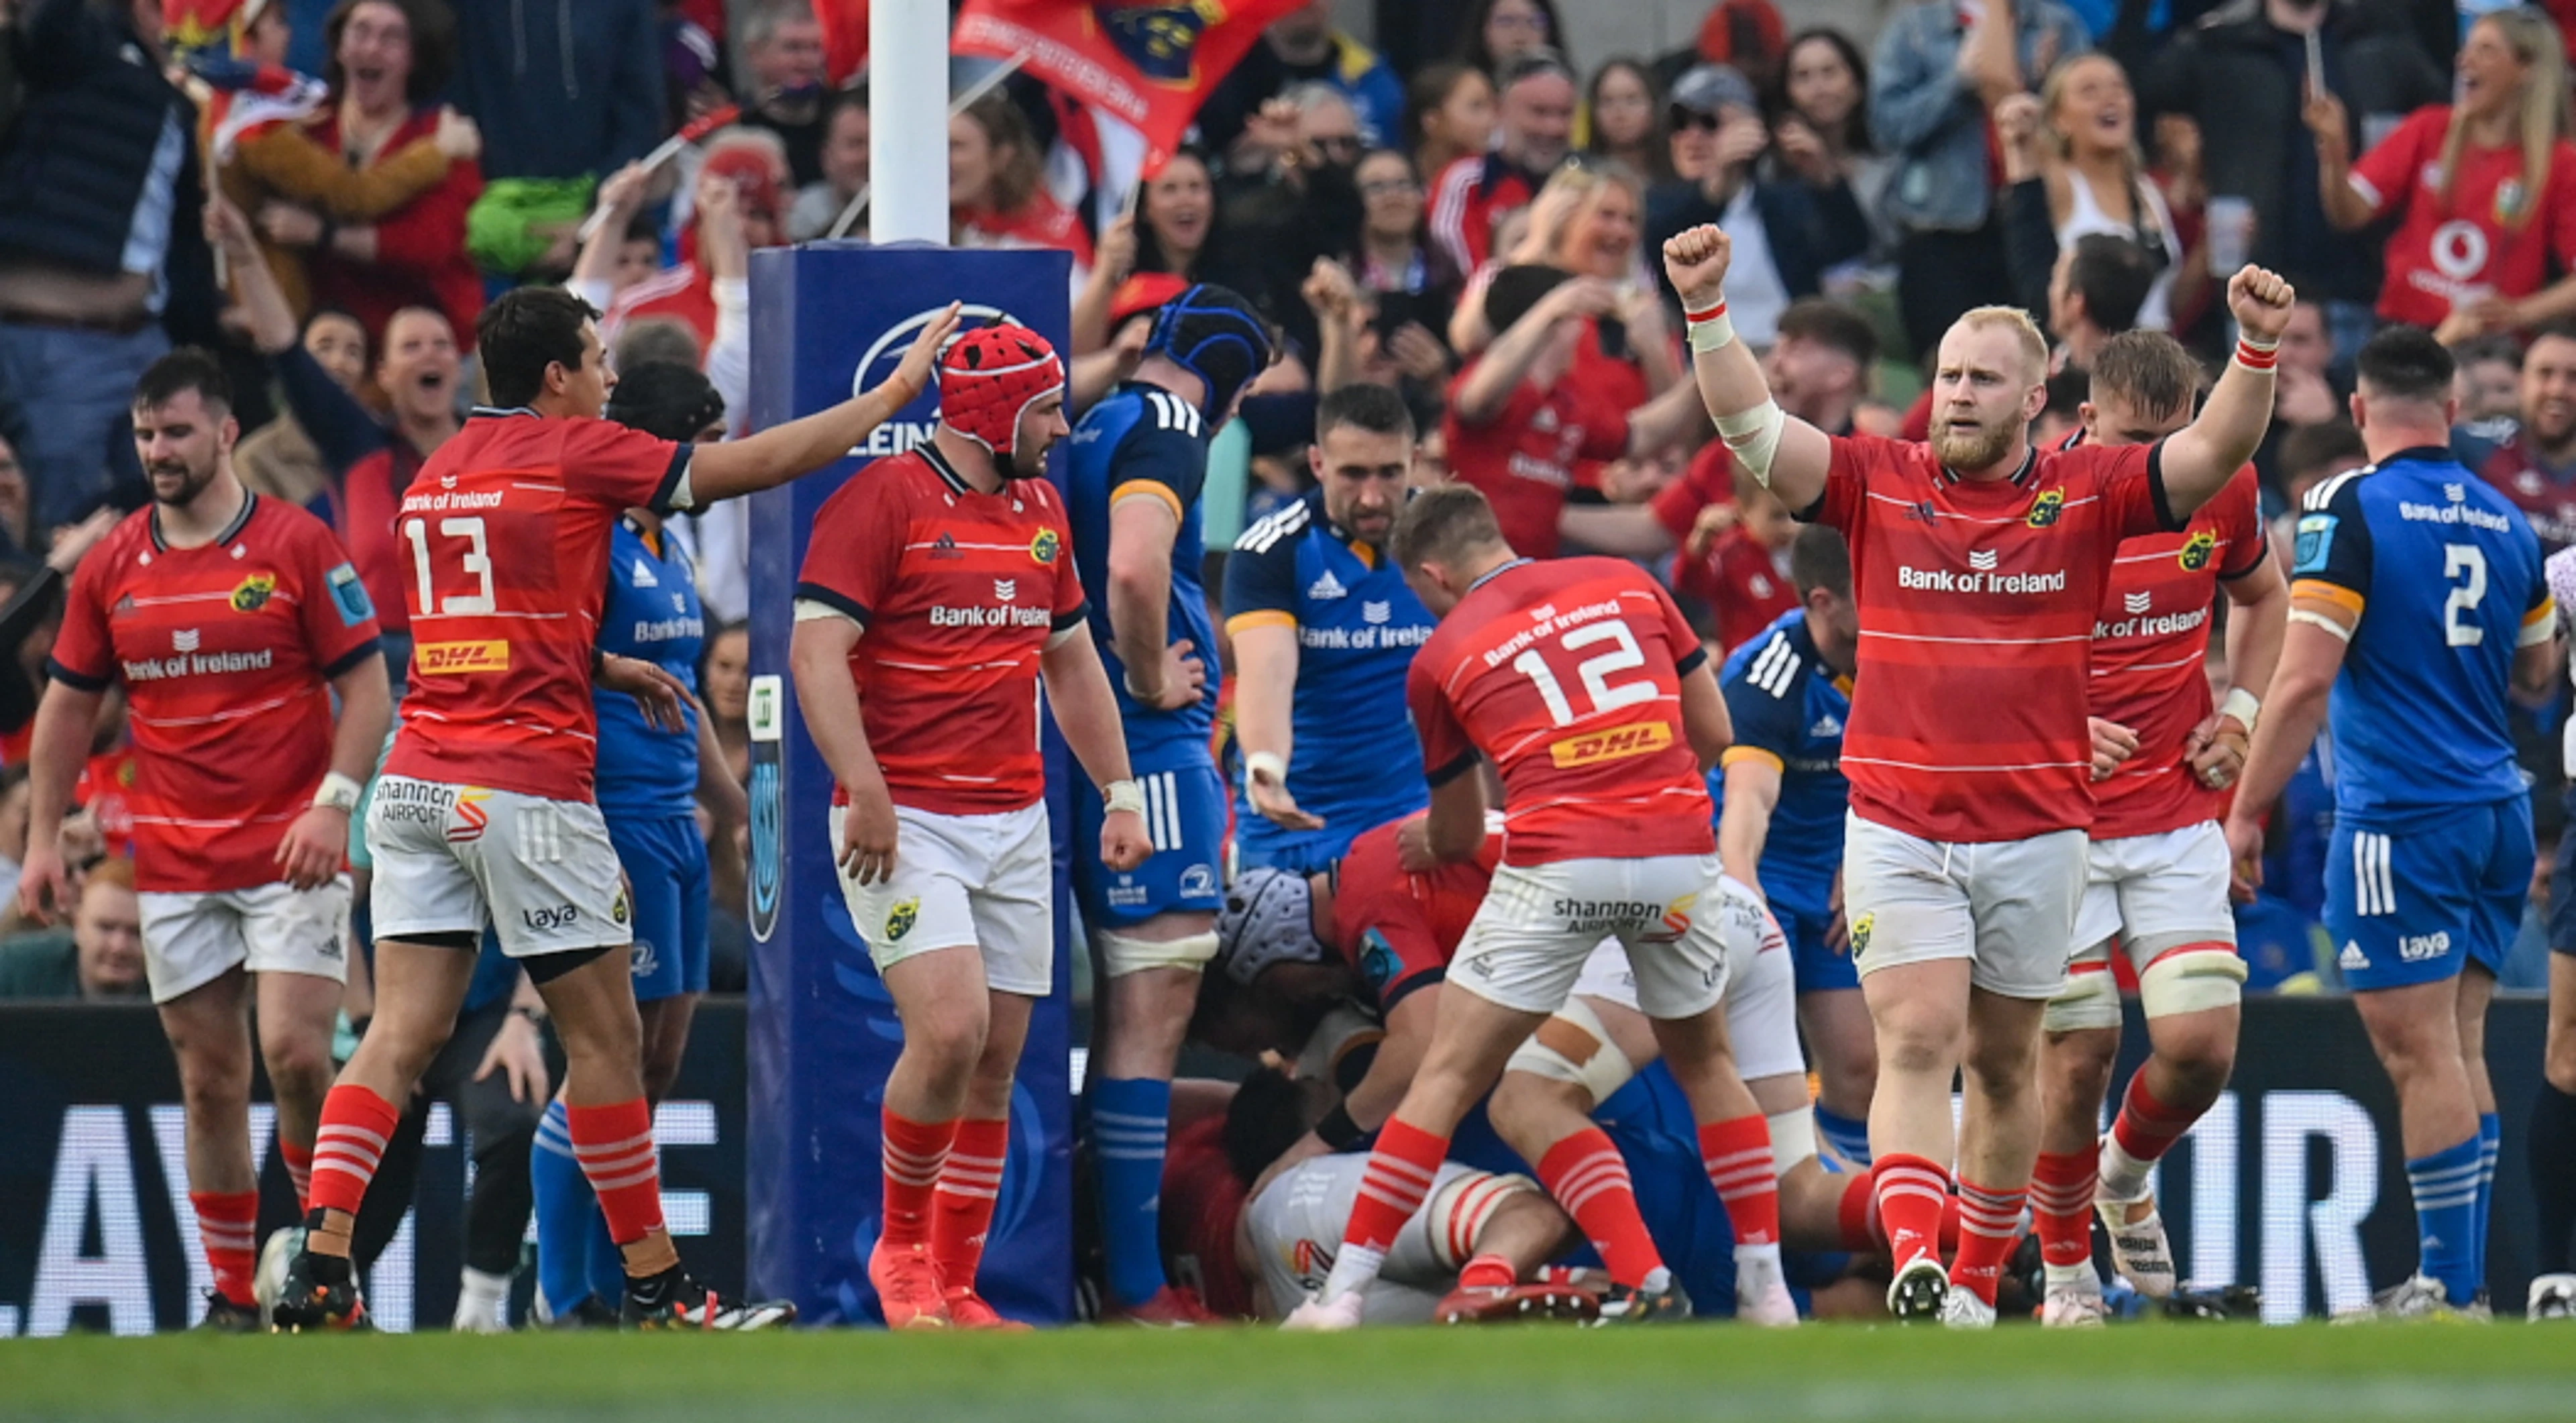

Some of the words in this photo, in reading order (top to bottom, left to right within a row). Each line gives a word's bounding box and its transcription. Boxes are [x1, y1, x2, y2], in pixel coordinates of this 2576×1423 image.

[402, 492, 433, 512] ank
[433, 492, 450, 510] of
[451, 490, 502, 509] Ireland
[405, 517, 496, 616] 13
[1898, 566, 1955, 592] Bank
[1957, 572, 1985, 593] of
[1987, 569, 2066, 594] Ireland
[2443, 543, 2487, 647] 2
[930, 605, 985, 627] Bank
[986, 604, 1010, 626] of
[1010, 606, 1051, 627] Irelan
[2113, 618, 2138, 638] of
[1351, 626, 1379, 649] of
[1380, 623, 1434, 648] Irela
[1483, 630, 1535, 668] Bank
[1532, 620, 1554, 638] of
[1554, 599, 1621, 629] Ireland
[166, 655, 189, 678] of
[191, 649, 273, 674] Ireland
[427, 645, 492, 668] DHL
[1513, 619, 1660, 727] 12
[1573, 729, 1658, 759] DHL
[523, 904, 578, 929] laya
[1554, 898, 1662, 919] shannon
[2398, 930, 2451, 960] laya
